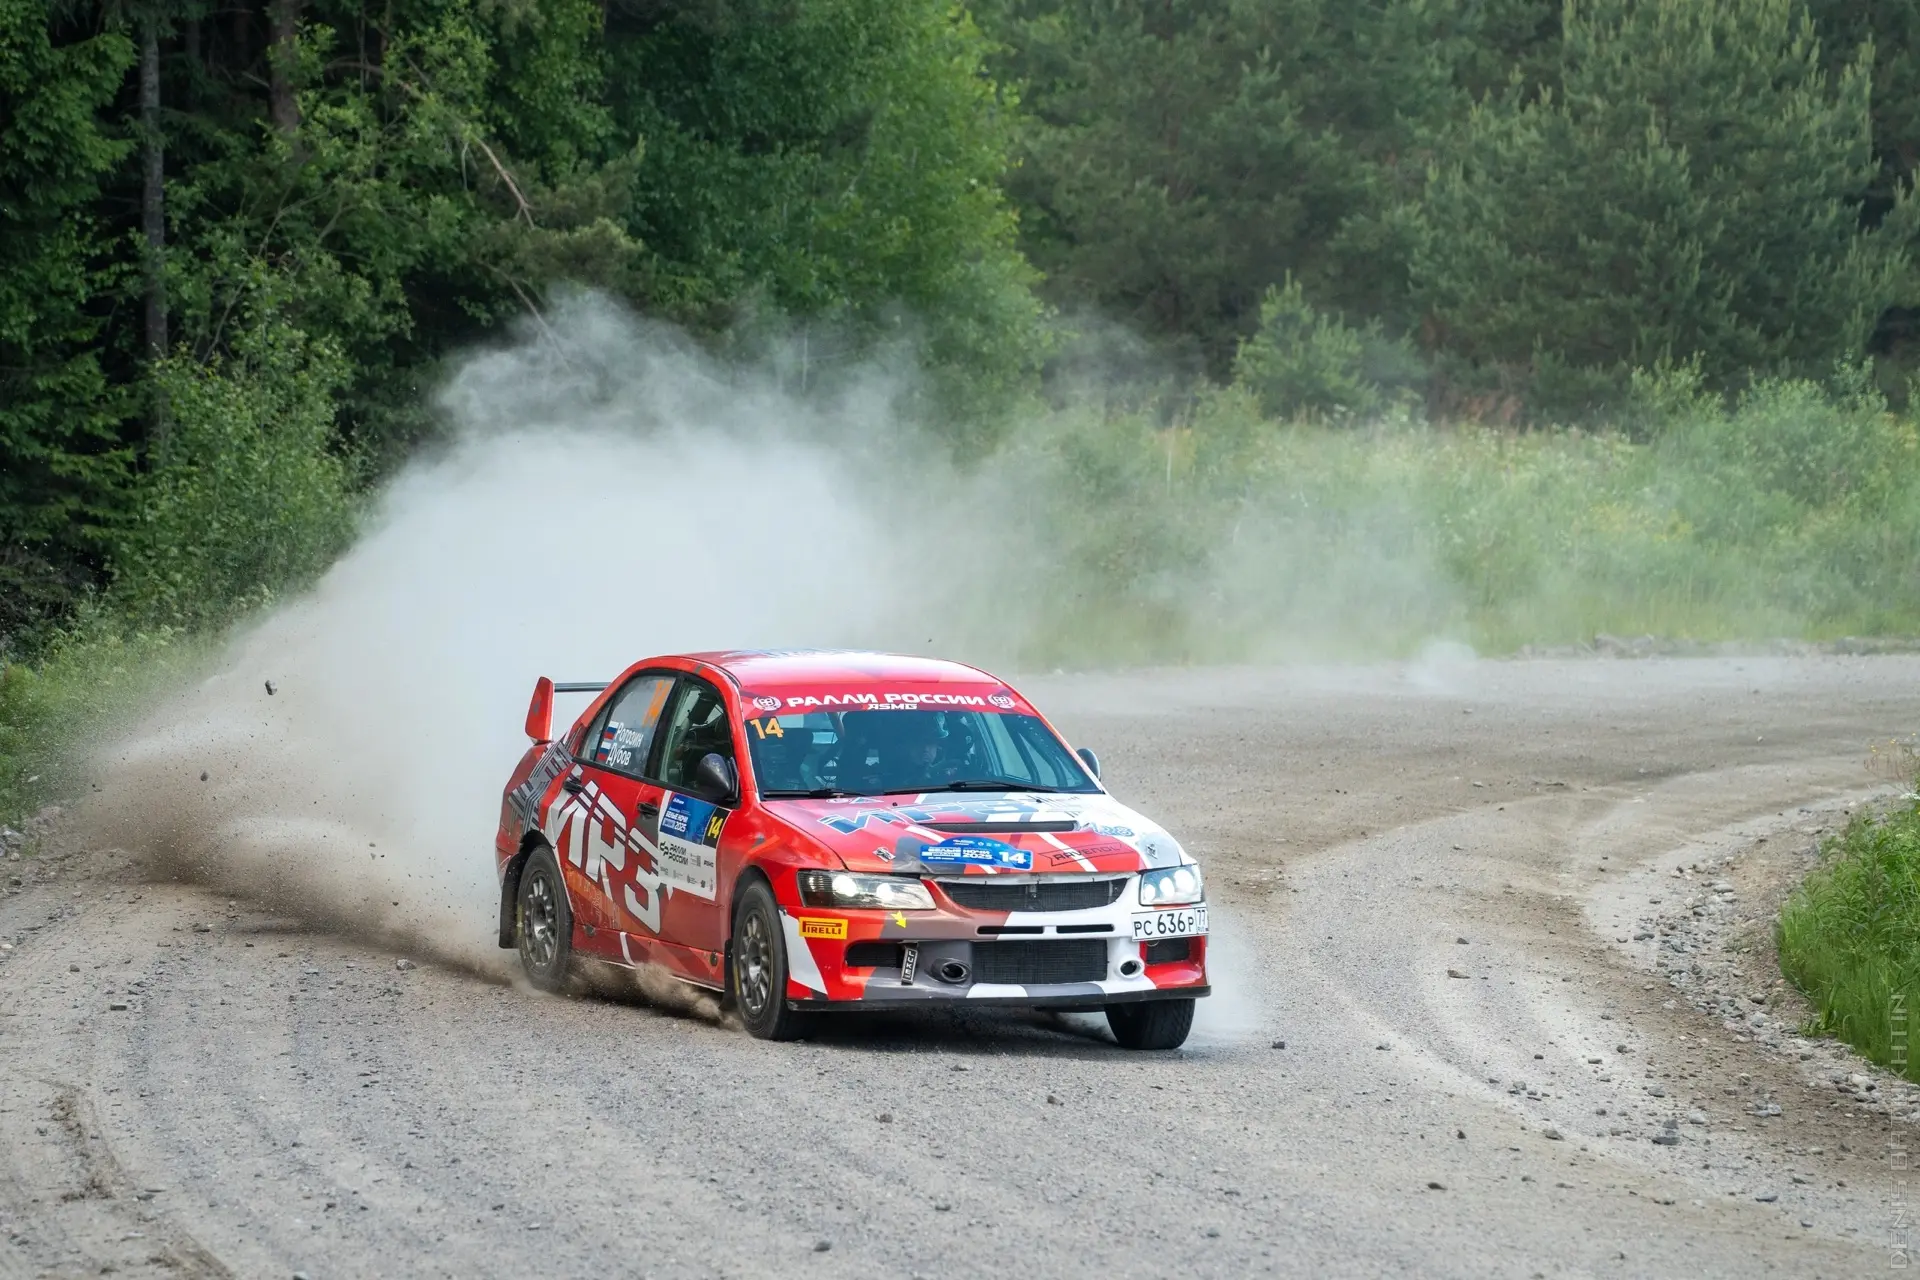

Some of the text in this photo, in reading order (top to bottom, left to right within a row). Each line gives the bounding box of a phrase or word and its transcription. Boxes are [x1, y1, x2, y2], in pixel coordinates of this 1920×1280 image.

[786, 693, 986, 707] РАЛЛИ РОССИИ
[615, 722, 644, 747] Рогозин
[750, 718, 784, 740] 14
[606, 744, 632, 767] Дубов
[707, 816, 724, 839] 14
[999, 851, 1027, 864] 14
[1053, 845, 1121, 861] RAVENOL
[802, 920, 843, 935] PIRELLI
[1157, 912, 1186, 934] 636
